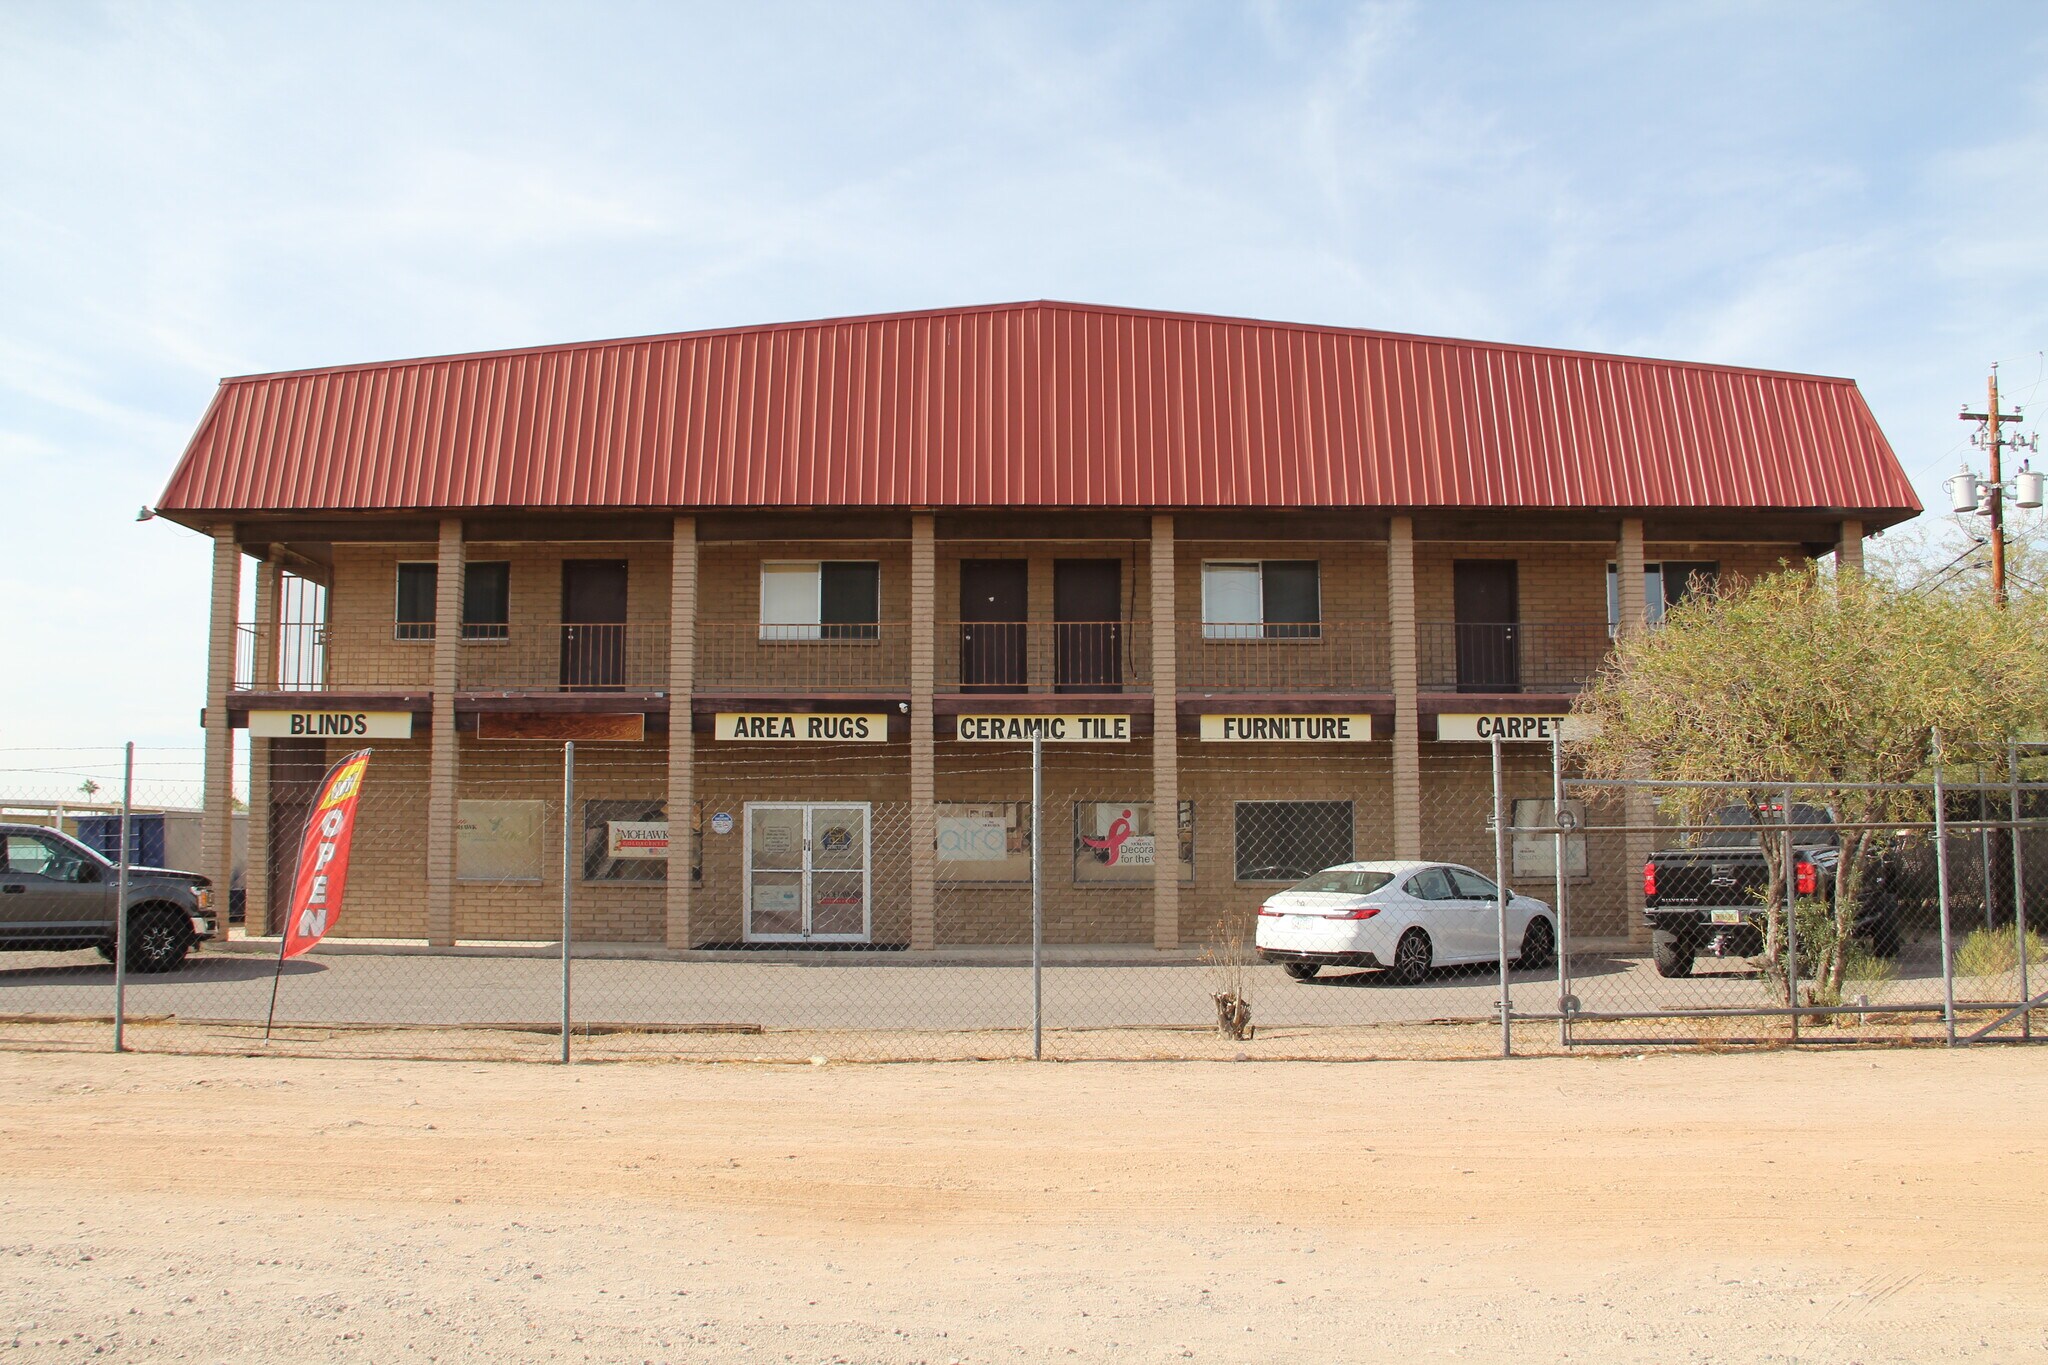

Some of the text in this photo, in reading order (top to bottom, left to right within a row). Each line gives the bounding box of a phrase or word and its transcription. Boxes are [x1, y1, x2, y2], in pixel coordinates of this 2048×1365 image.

[290, 714, 367, 735] BLINDS
[734, 717, 869, 738] AREA RUGS
[959, 717, 1127, 740] CERAMIC TILE
[1223, 717, 1351, 739] FURNITURE
[1476, 716, 1565, 738] CARPET
[621, 829, 668, 840] MOHAWK
[1120, 855, 1133, 863] for
[1136, 855, 1150, 863] the
[298, 808, 344, 938] OPEN
